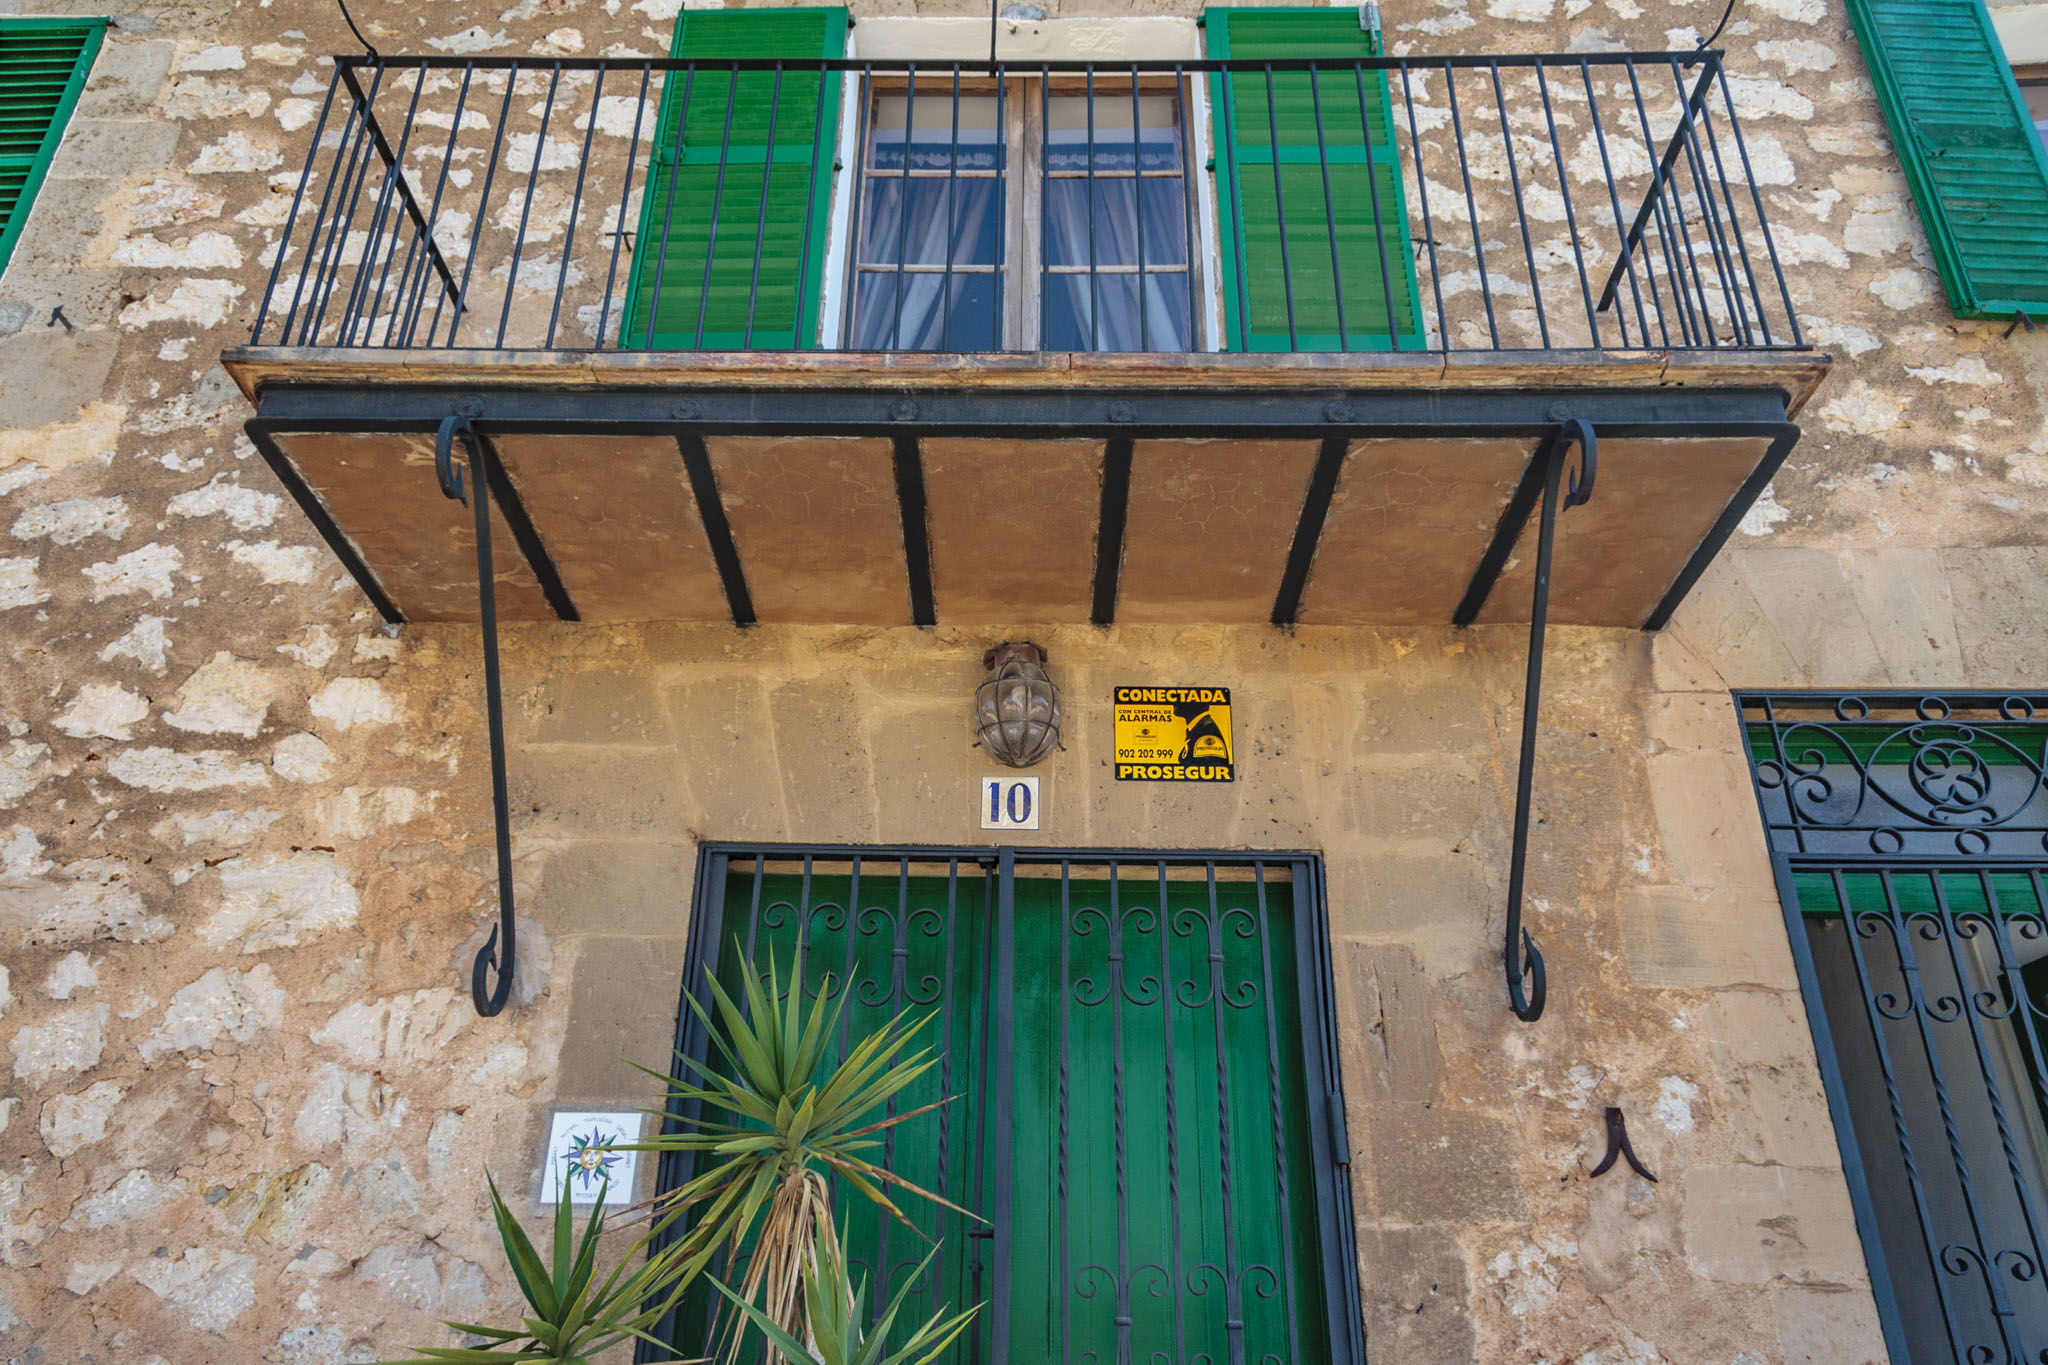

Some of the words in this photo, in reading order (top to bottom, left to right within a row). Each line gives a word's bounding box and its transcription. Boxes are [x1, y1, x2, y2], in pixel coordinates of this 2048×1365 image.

[1118, 688, 1226, 702] CONECTADA
[1119, 714, 1172, 722] ALARMAS
[1118, 749, 1135, 758] 902
[1137, 749, 1154, 758] 202
[1157, 749, 1173, 759] 999
[1120, 765, 1231, 780] PROSEGUR
[988, 782, 1031, 824] 10
